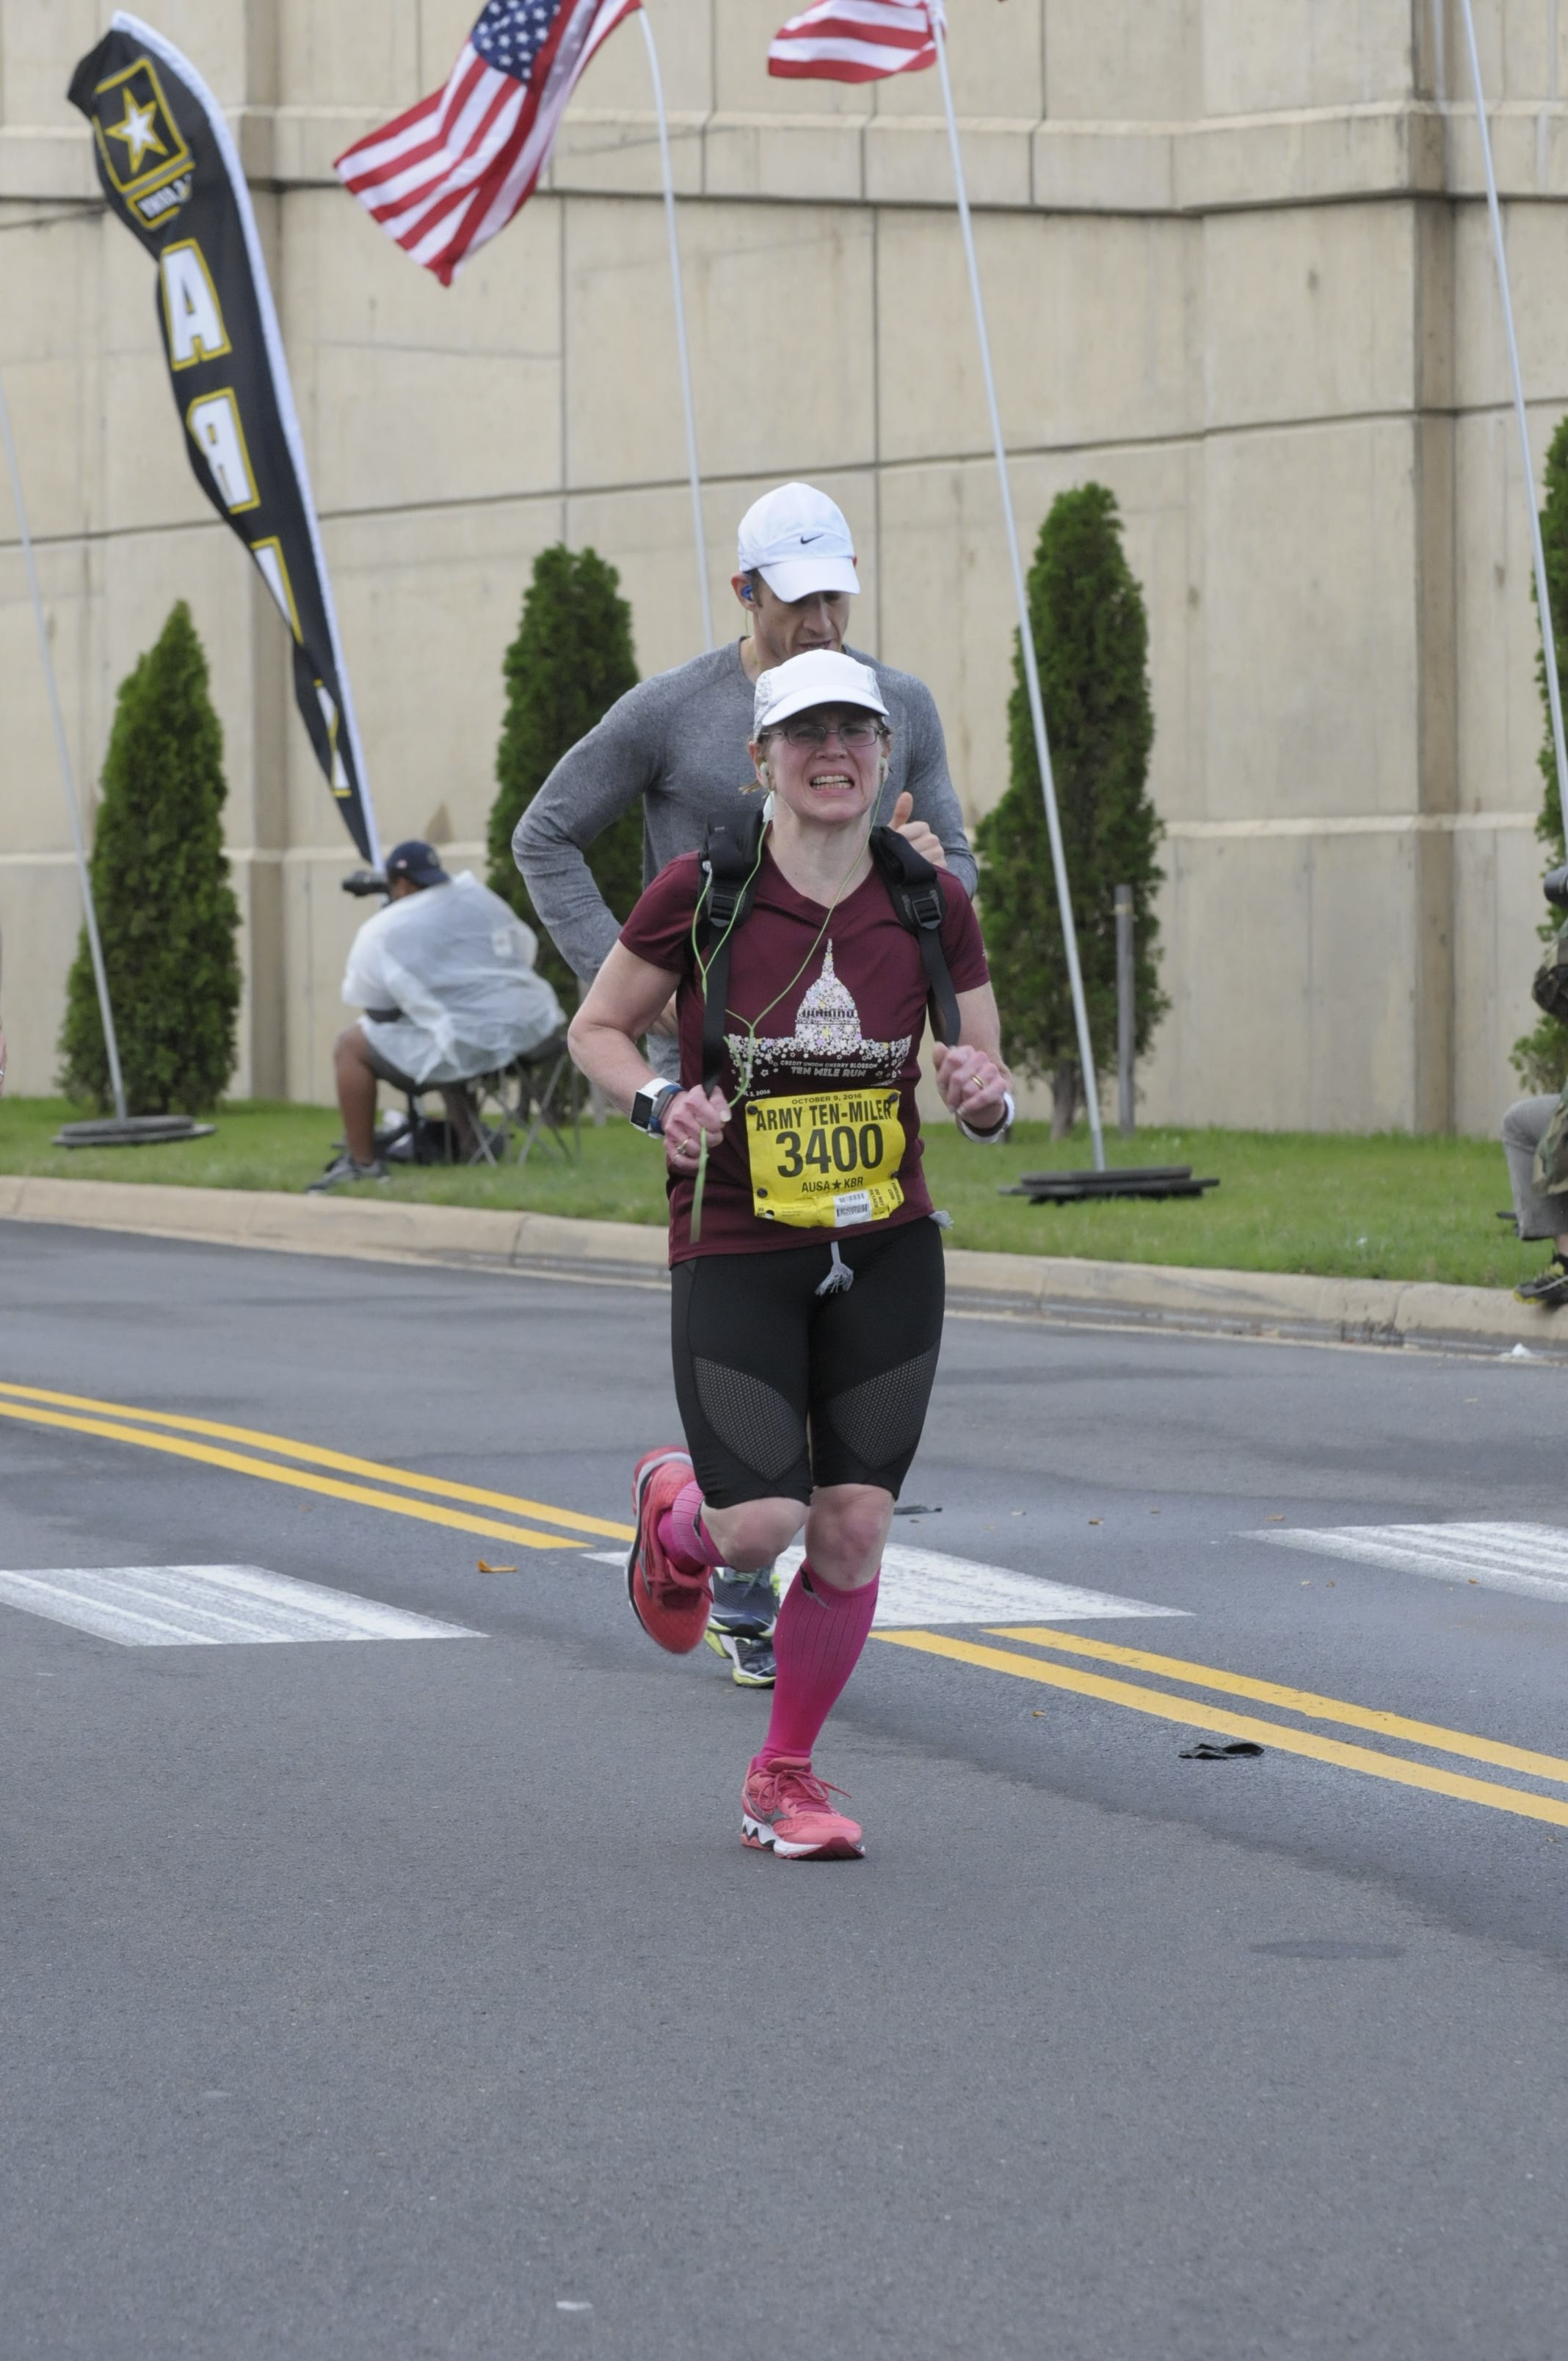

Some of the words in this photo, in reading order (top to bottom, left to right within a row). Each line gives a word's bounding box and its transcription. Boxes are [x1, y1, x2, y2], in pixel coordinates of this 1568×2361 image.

[791, 1067, 812, 1075] TEN
[813, 1067, 841, 1077] MILE
[842, 1069, 866, 1077] RUN
[791, 1096, 831, 1105] OCTOBER
[756, 1106, 803, 1131] ARMY
[809, 1099, 893, 1126] TEN-MILER
[775, 1123, 884, 1178] 3400
[802, 1179, 830, 1192] AUSA
[844, 1177, 863, 1189] KBR
